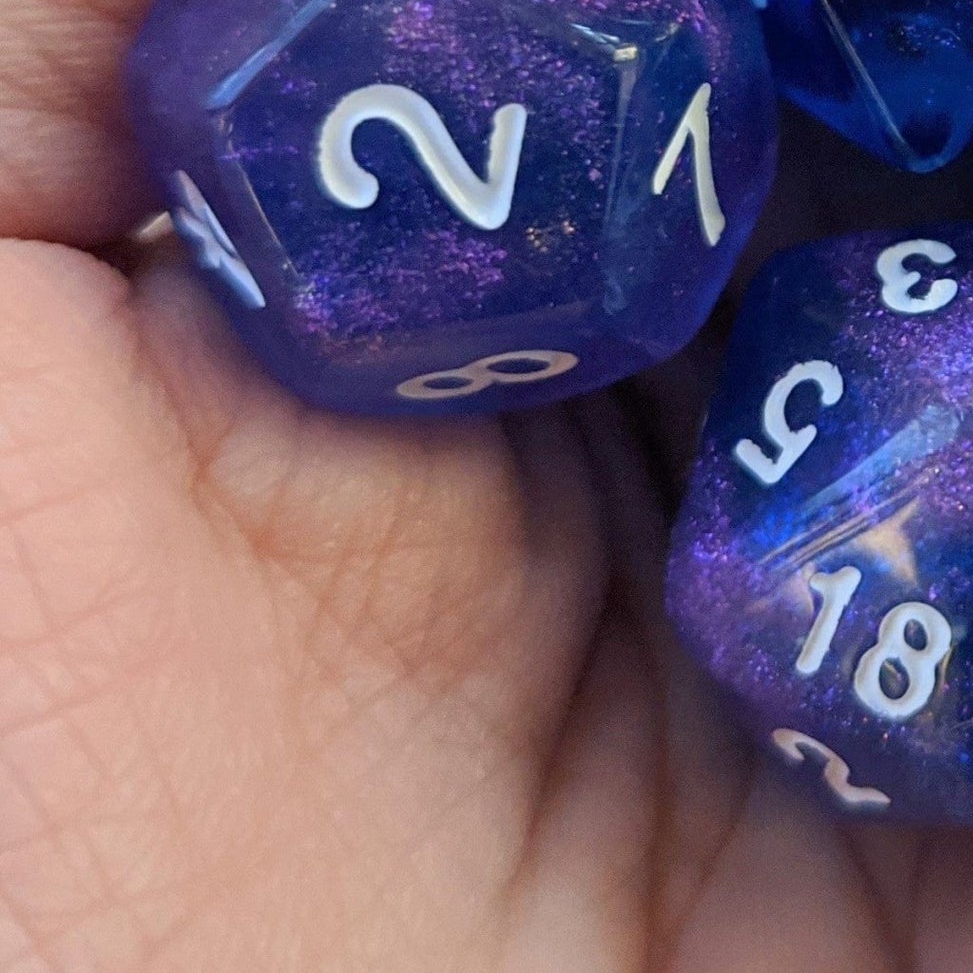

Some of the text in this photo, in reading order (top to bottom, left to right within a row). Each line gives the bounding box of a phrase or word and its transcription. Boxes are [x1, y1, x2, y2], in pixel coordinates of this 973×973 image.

[319, 83, 528, 230] 2
[395, 349, 579, 400] 8
[734, 359, 844, 484] 5
[796, 566, 952, 719] 18
[772, 728, 891, 806] 2
